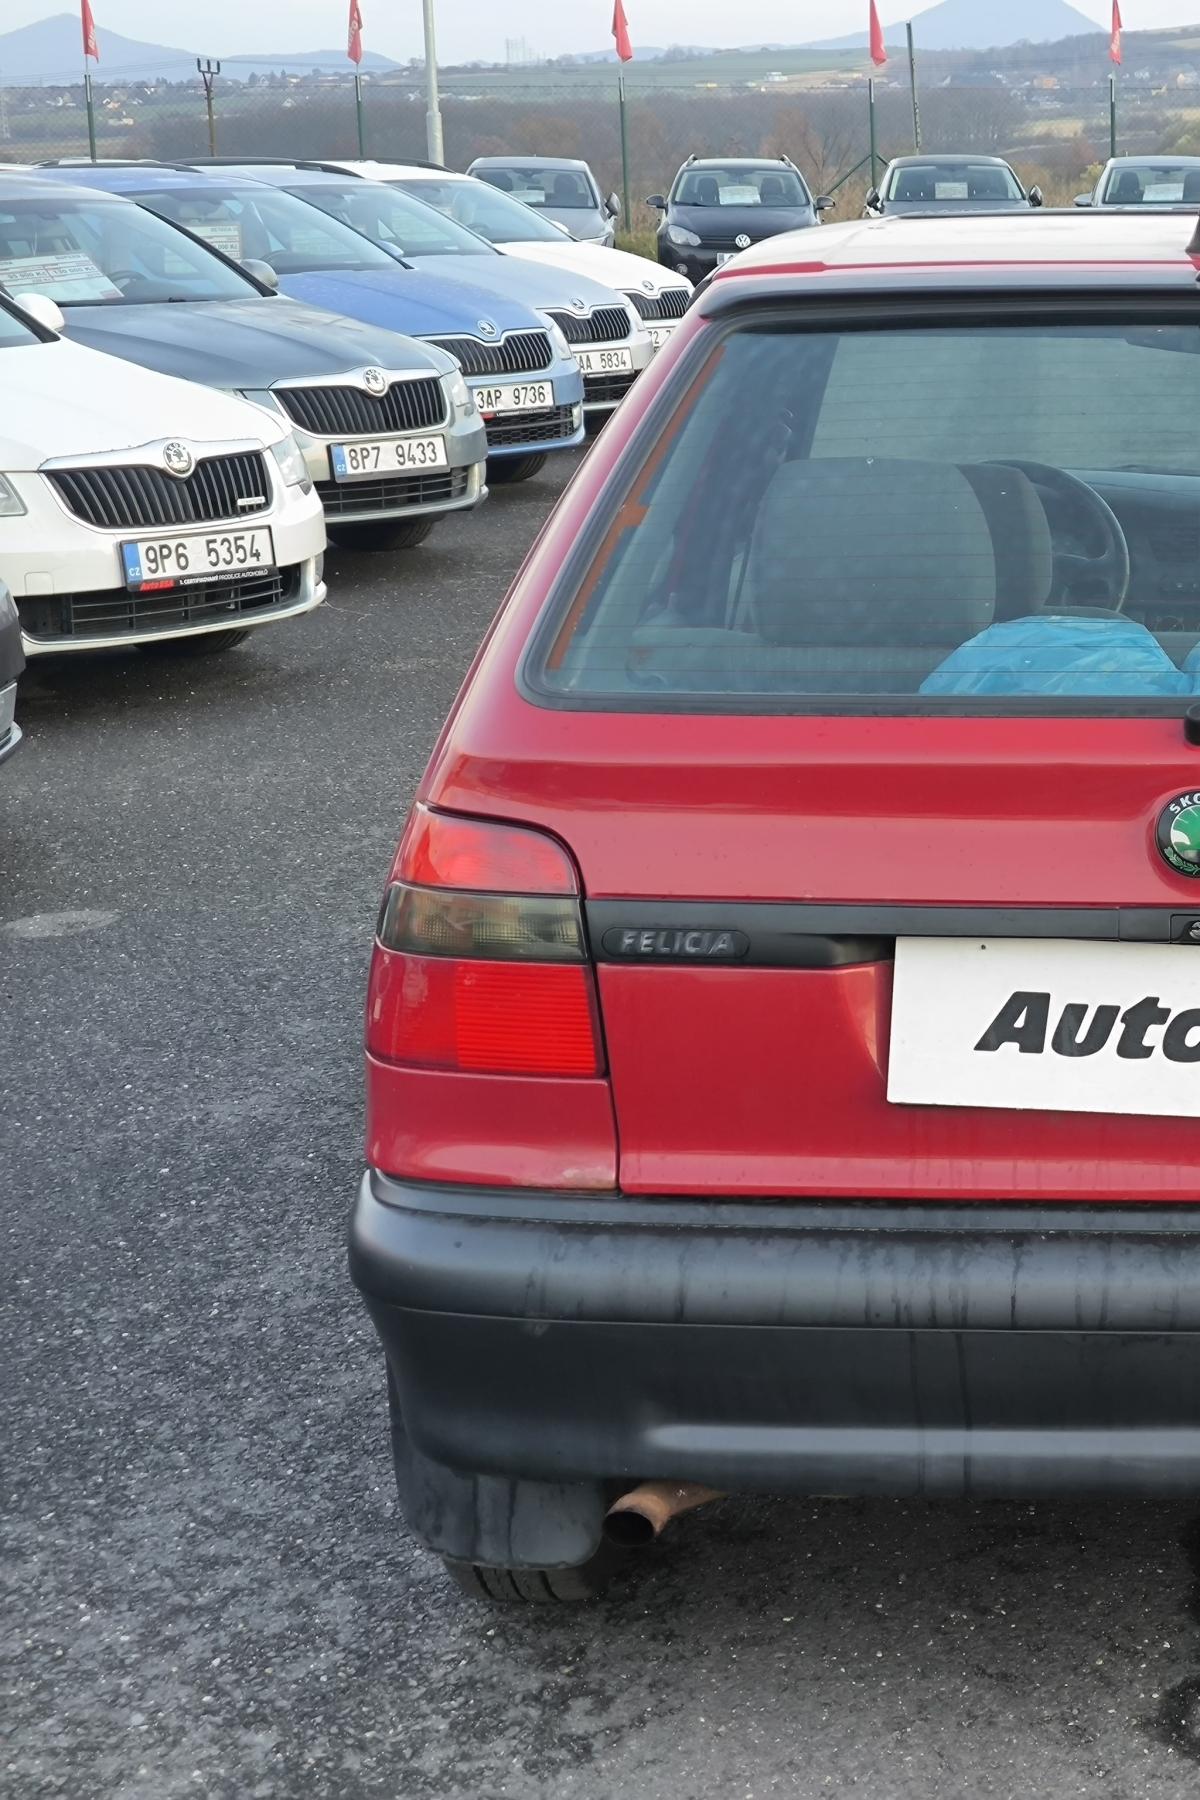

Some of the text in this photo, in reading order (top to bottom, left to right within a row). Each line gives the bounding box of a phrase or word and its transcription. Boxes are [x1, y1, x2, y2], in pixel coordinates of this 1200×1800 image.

[575, 351, 627, 371] AA 5834
[476, 385, 546, 409] 3AP 9736
[348, 441, 437, 471] 8P7 9433
[145, 534, 261, 574] 9P6 5354
[128, 566, 141, 577] CZ
[621, 930, 735, 955] FELICIA
